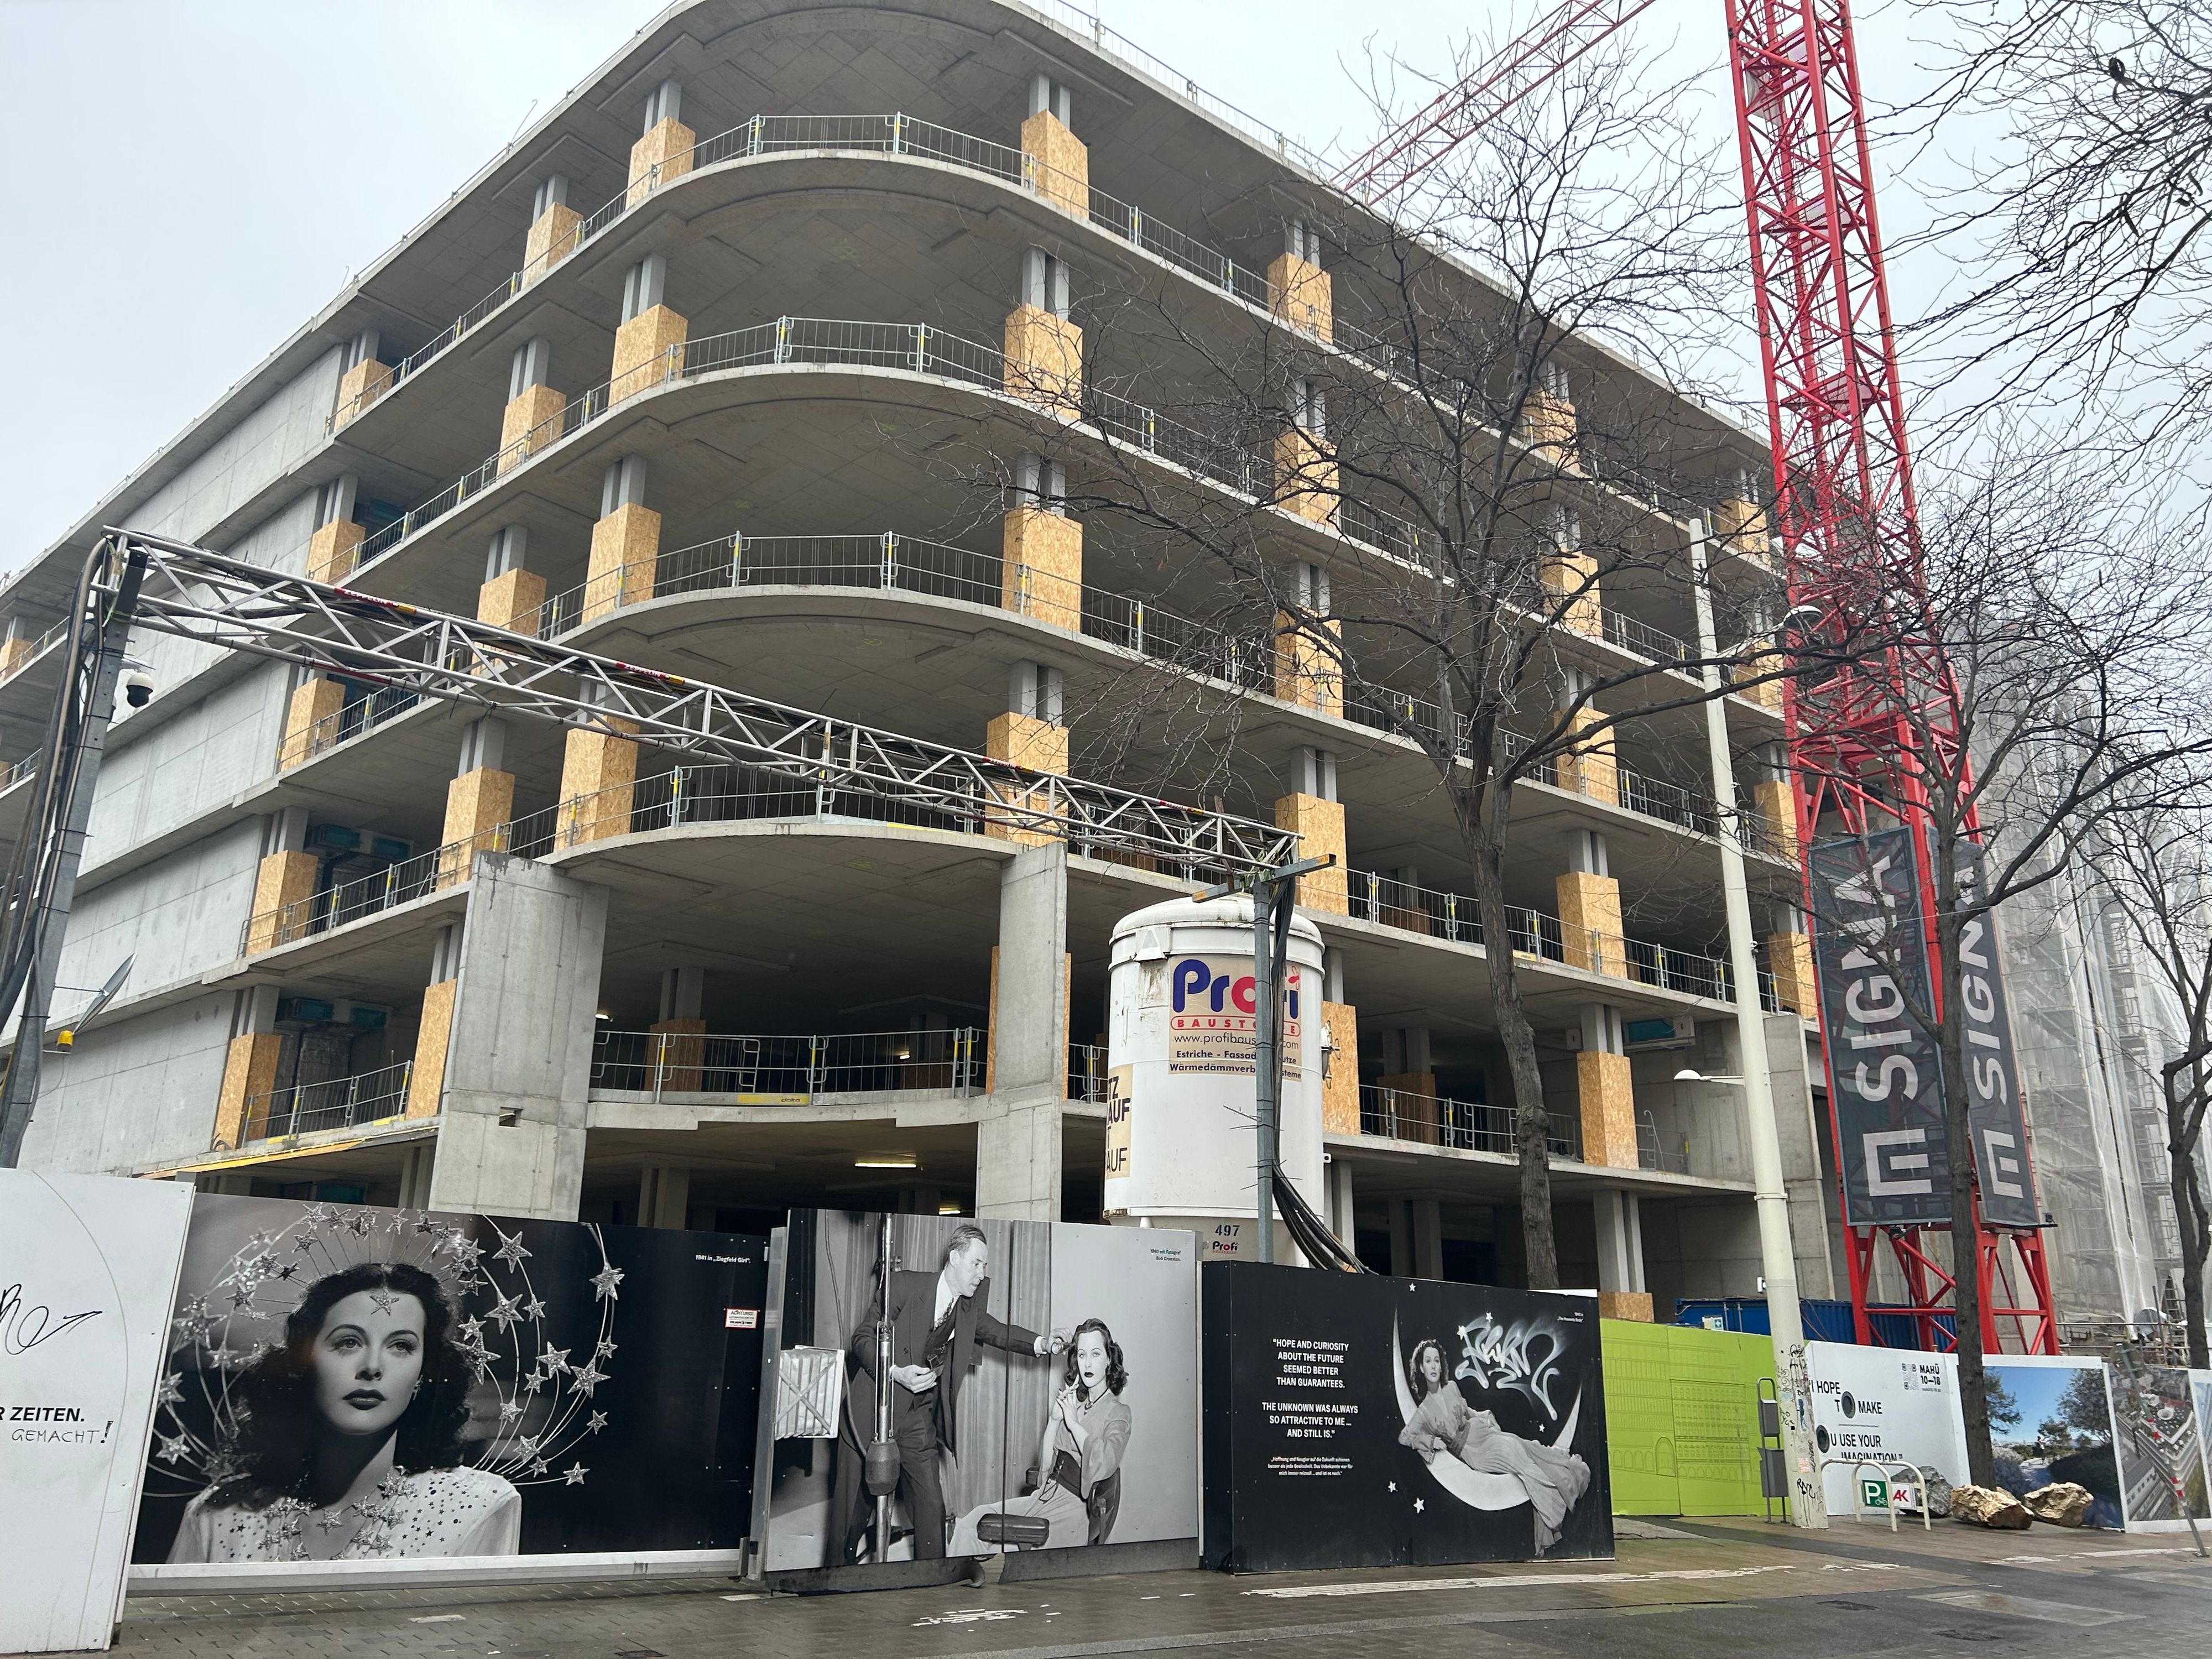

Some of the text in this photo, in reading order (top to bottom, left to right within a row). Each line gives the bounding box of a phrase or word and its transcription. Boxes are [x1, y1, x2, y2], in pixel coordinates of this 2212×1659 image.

[1173, 959, 1298, 1019] Proi
[1177, 1018, 1296, 1034] BAUSTE
[1174, 1032, 1298, 1050] www.profibauscom
[1224, 1051, 1297, 1064] Fassadutze
[1170, 1063, 1302, 1079] Wärmedämmverbsteme
[1215, 1224, 1240, 1237] 497
[1213, 1241, 1238, 1250] Profi
[1297, 1340, 1312, 1349] AND
[1313, 1341, 1349, 1352] CURIOSITY
[1277, 1352, 1344, 1363] ABOUT THE FUTURE
[1283, 1364, 1339, 1375] SEEMED BETTER
[1276, 1377, 1345, 1389] THAN GUARANTEES.
[1817, 1380, 1841, 1395] HOPE
[9, 1407, 85, 1422] ZEITEN.
[1262, 1402, 1359, 1413] THE UNKNOWN WAS ALWAYS
[1858, 1400, 1882, 1415] MAKE
[1269, 1415, 1280, 1425] SO
[1281, 1416, 1323, 1425] ATTRACTIVE
[1324, 1417, 1334, 1426] TO
[1334, 1417, 1345, 1426] ME
[12, 1420, 114, 1444] GEMACHT!
[1287, 1428, 1303, 1438] AND
[1303, 1429, 1322, 1438] STILL
[1840, 1433, 1856, 1447] USE
[1858, 1434, 1881, 1448] YOUR
[1864, 1481, 1881, 1504] P
[1893, 1489, 1910, 1503] AK
